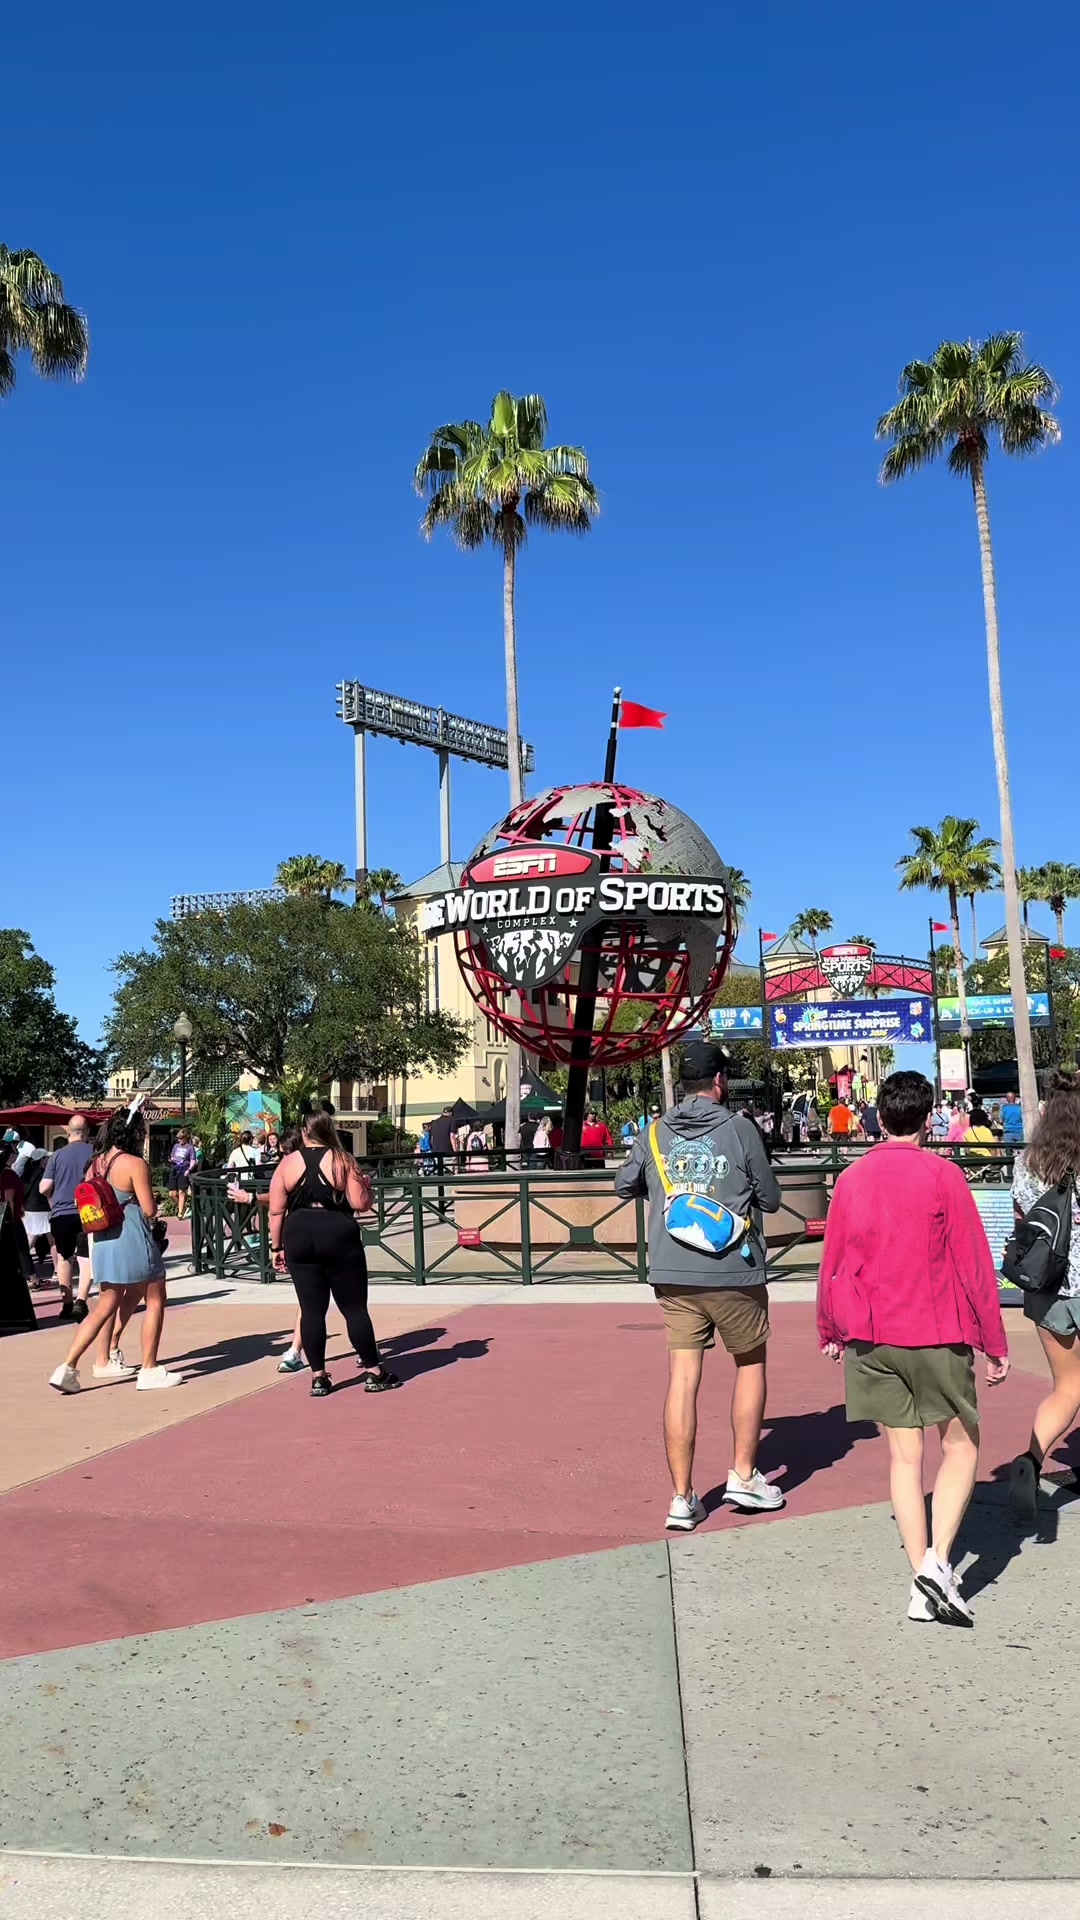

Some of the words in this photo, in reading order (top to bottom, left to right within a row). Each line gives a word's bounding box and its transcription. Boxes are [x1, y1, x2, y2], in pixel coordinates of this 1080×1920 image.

[493, 852, 556, 878] ESPN
[445, 886, 550, 923] WORLD
[556, 886, 595, 914] OF
[599, 877, 724, 913] SPORTS
[497, 916, 556, 929] COMPLEX
[821, 960, 871, 973] SPORTS
[720, 1009, 737, 1018] BIB
[967, 1006, 994, 1015] ICK-UP
[793, 1018, 852, 1032] SPRINGTIME
[854, 1017, 901, 1030] SURPRISE
[805, 1030, 867, 1038] WEEKEND
